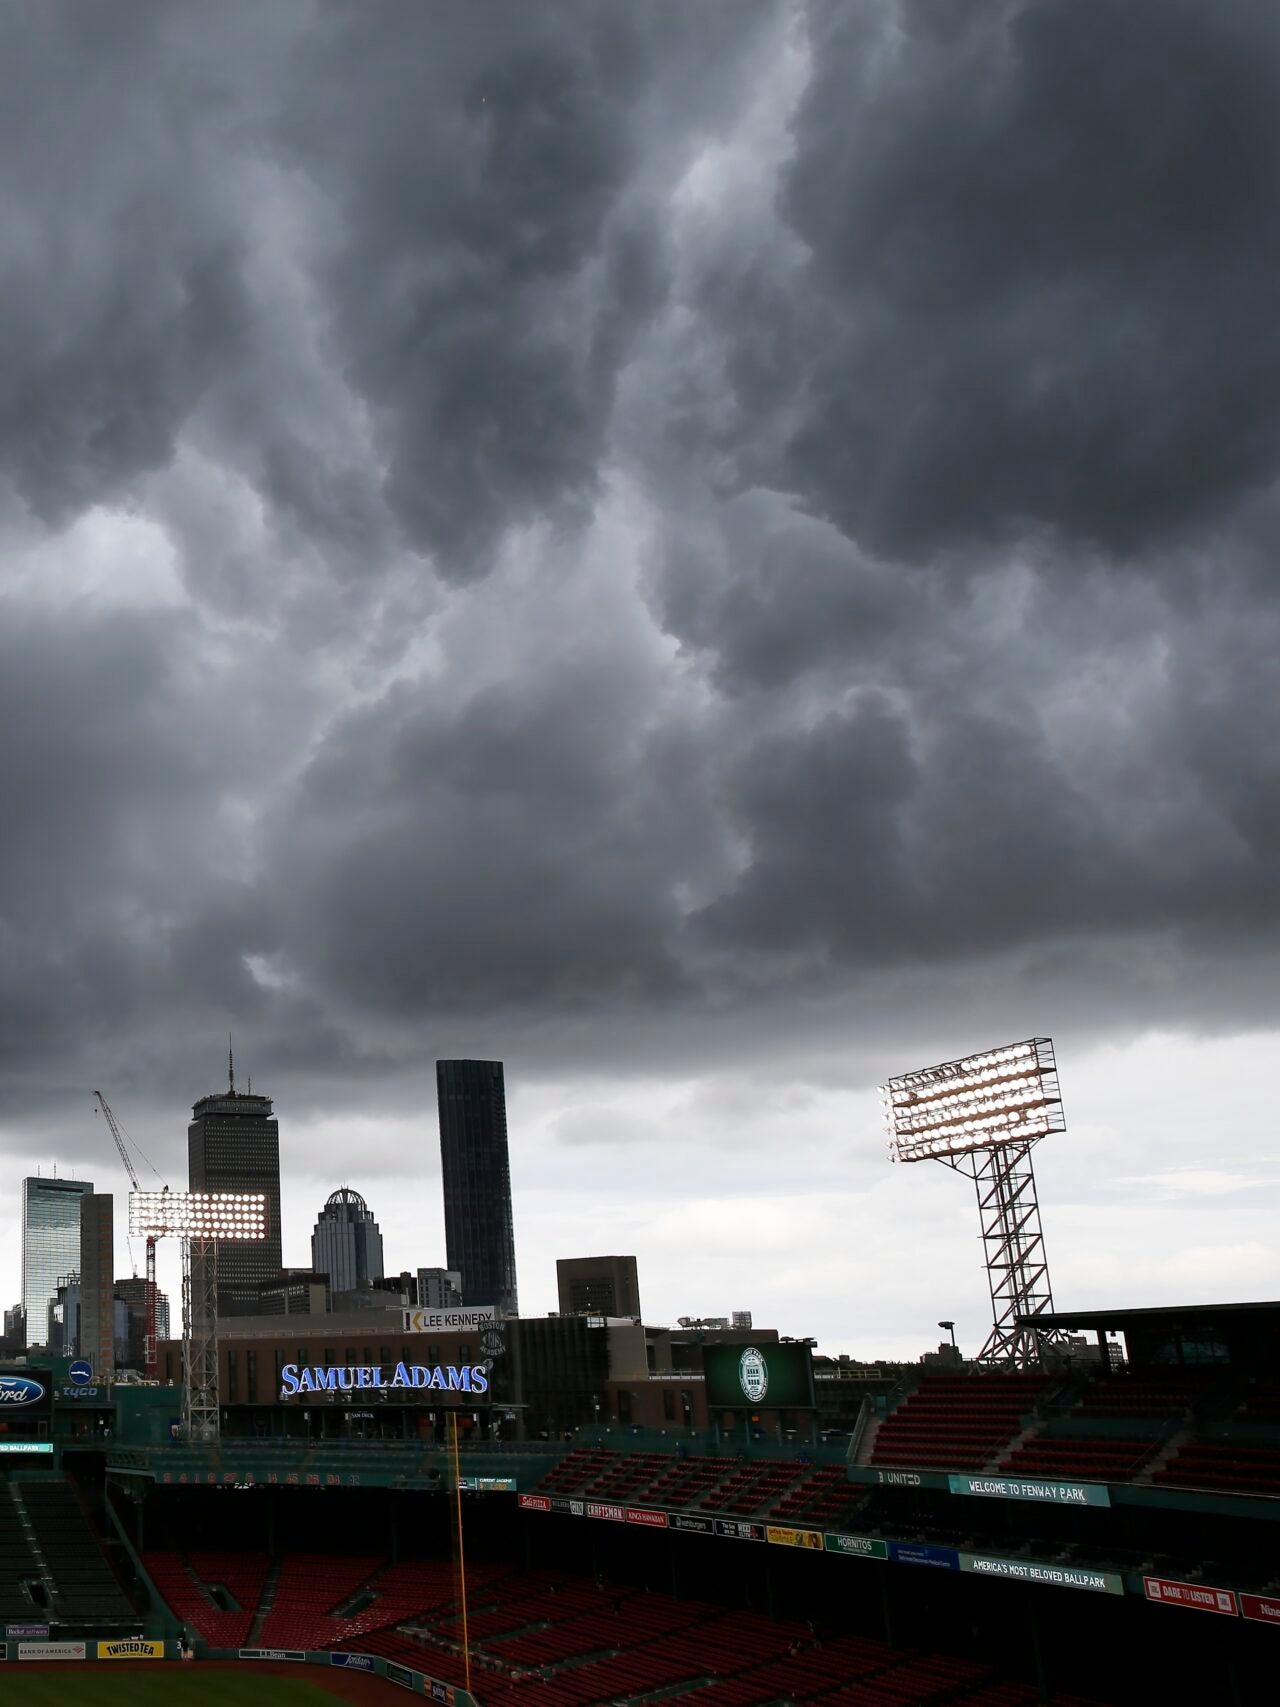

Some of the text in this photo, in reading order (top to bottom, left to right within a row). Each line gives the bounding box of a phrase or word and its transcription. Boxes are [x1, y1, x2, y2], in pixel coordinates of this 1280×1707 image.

[424, 1312, 492, 1327] LEE KENNEDY
[282, 1361, 488, 1395] SAMUEL ADAMS
[63, 1387, 98, 1398] tyco
[887, 1473, 920, 1485] UNITED
[969, 1481, 1086, 1501] WELCOME TO FENWAY PARK
[587, 1504, 623, 1519] CRAFTSMAN
[837, 1536, 872, 1551] HORNITOS
[973, 1560, 1106, 1588] AMERICA'S MOST BELOVED BALLPARK
[1162, 1585, 1182, 1599] DARE
[1183, 1590, 1190, 1599] TO
[1190, 1591, 1215, 1605] LISTEN
[106, 1643, 154, 1656] TWISTED TEA
